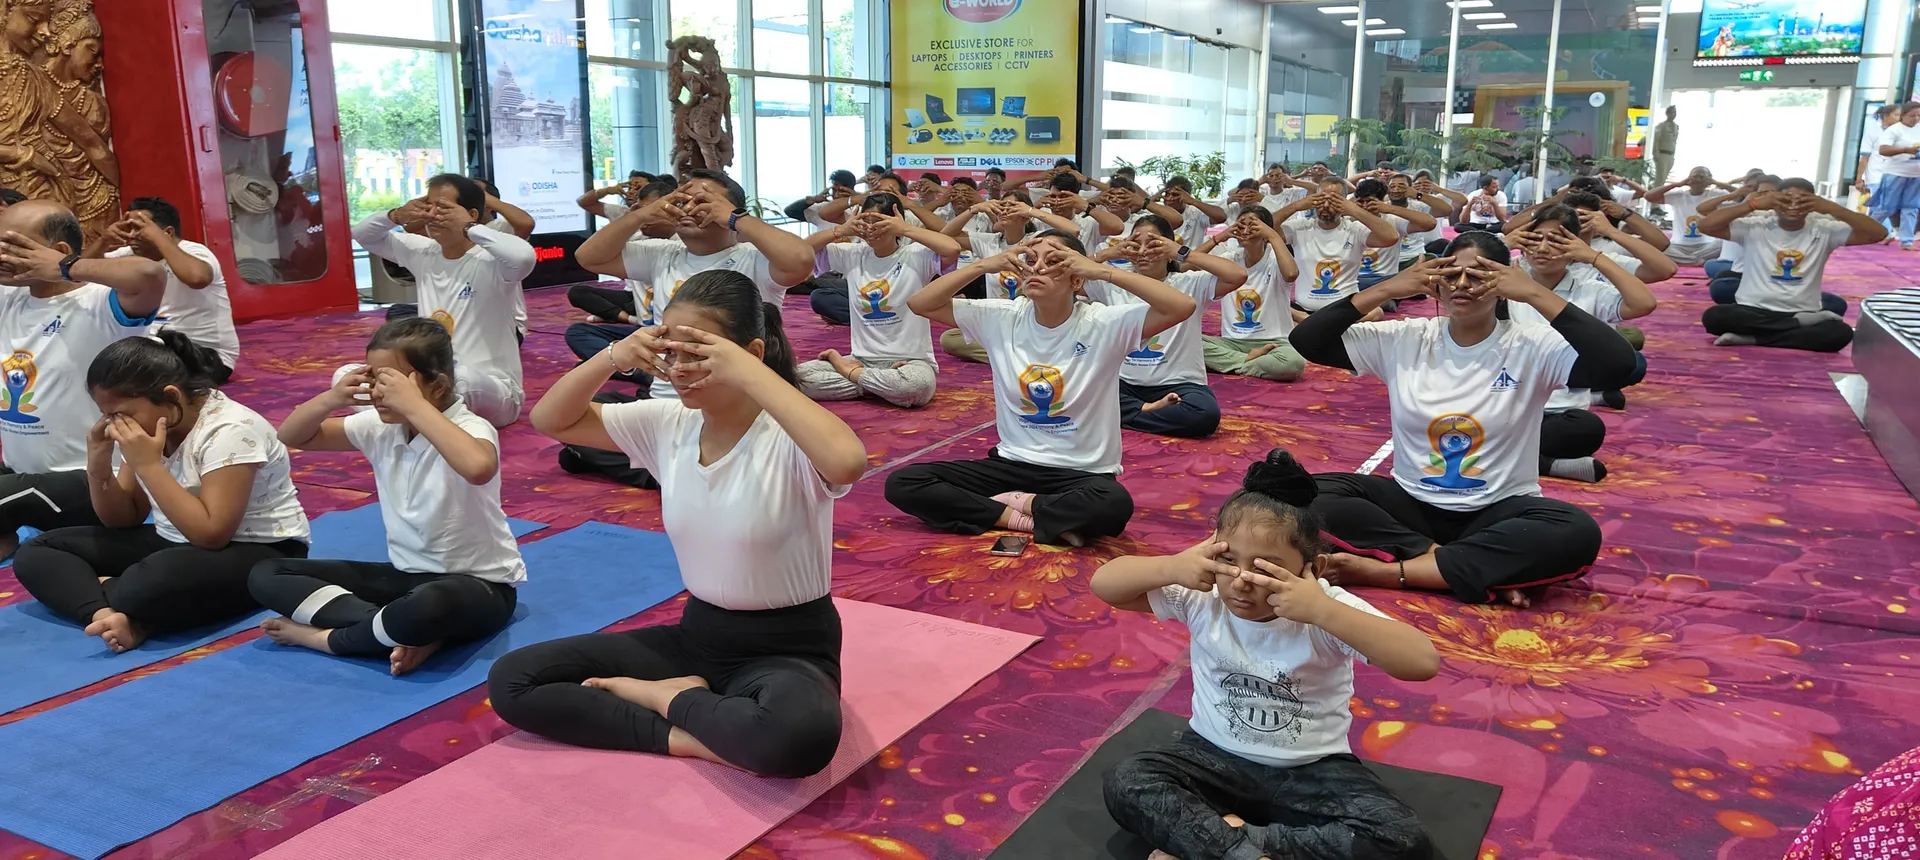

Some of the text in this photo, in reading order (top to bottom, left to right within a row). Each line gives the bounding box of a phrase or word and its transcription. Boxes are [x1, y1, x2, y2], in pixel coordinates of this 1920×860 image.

[930, 38, 1033, 50] EXCLUSIVE STORE FOR
[912, 50, 1054, 62] LAPTOPS DESKTOPS PRINTERS
[934, 61, 1030, 71] ACCESSORIES CCTV
[909, 158, 930, 166] acer
[980, 157, 1002, 166] DELL
[1034, 158, 1046, 166] CP
[532, 182, 558, 190] ODISHA
